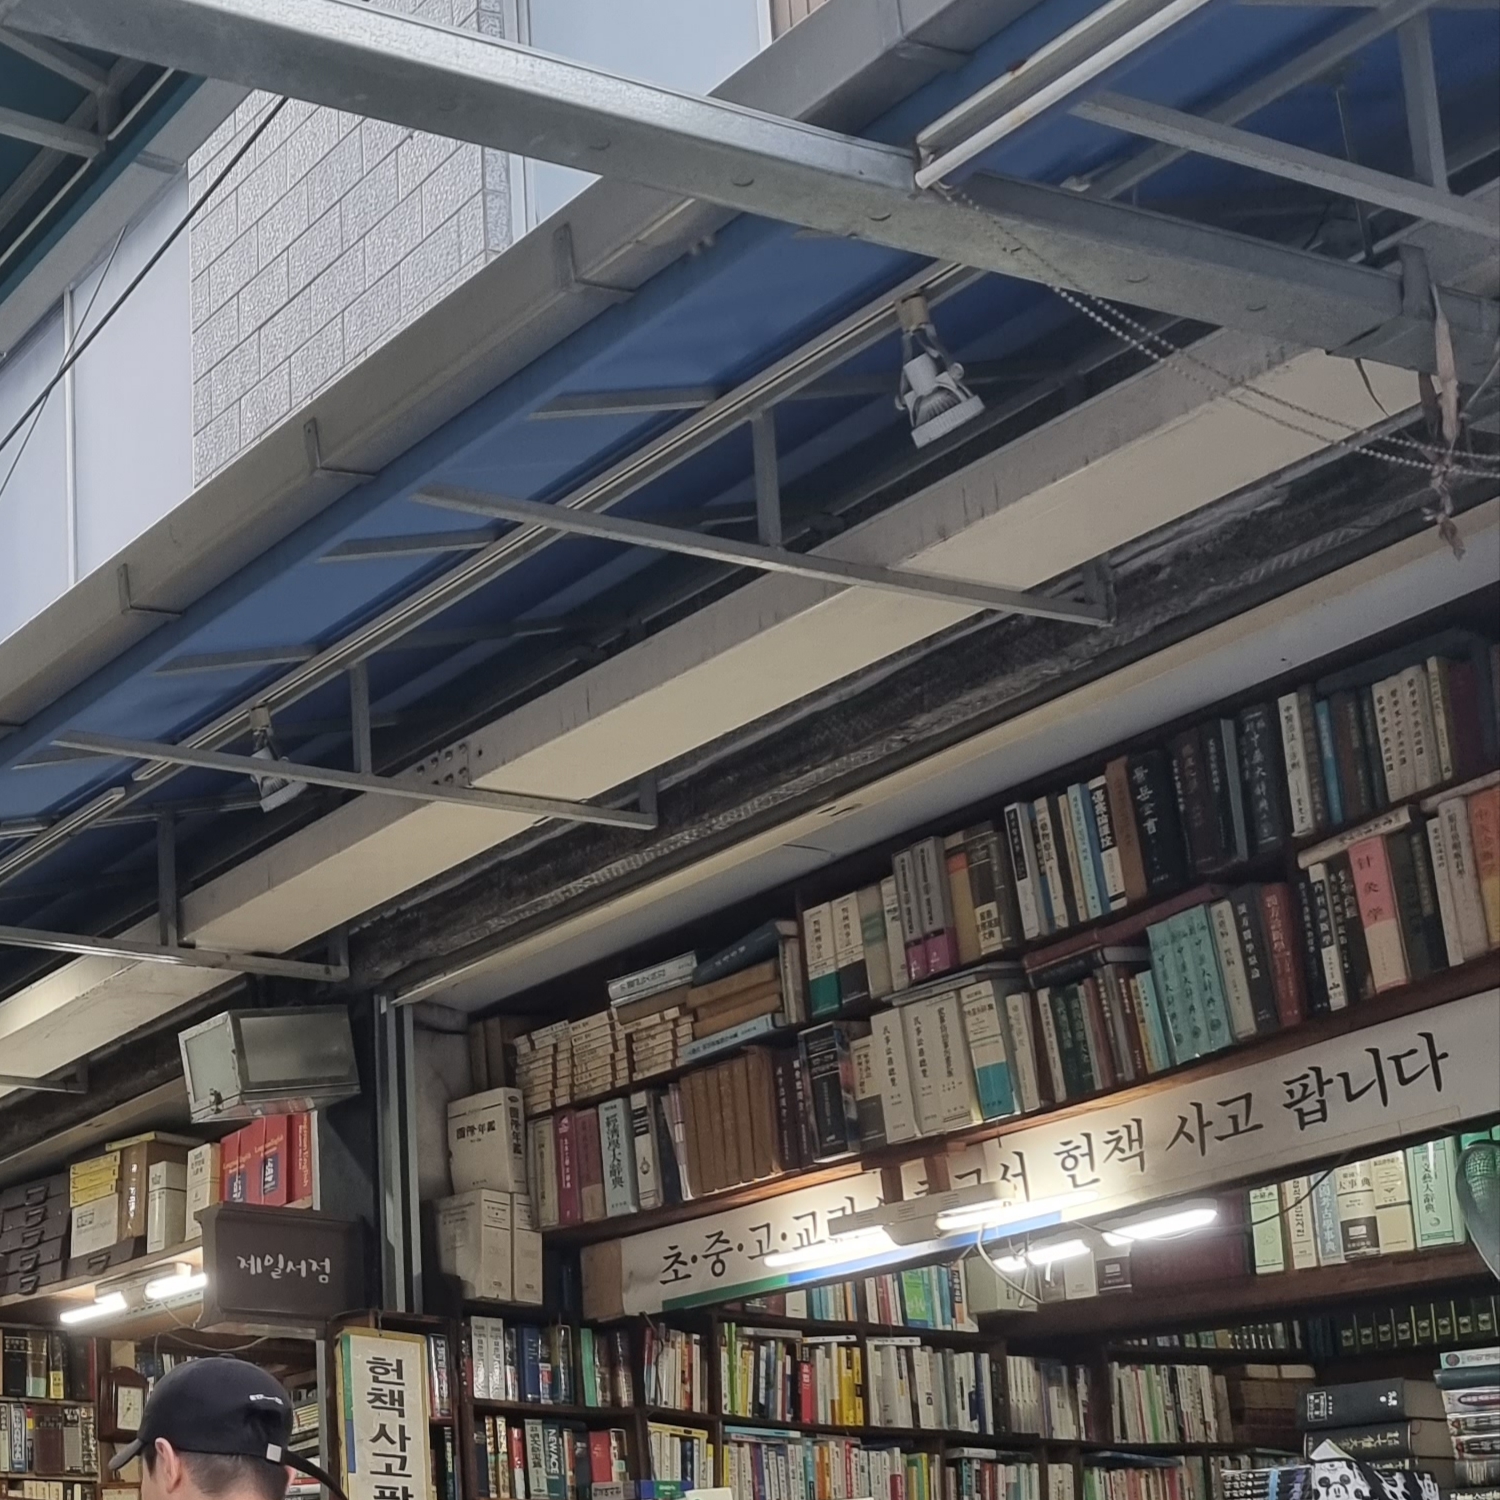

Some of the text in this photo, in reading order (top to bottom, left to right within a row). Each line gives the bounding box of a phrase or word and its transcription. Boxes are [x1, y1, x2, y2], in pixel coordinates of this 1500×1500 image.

[1054, 1117, 1145, 1186] 헌책
[1165, 1092, 1264, 1157] 사고
[1282, 1031, 1450, 1131] 팝니다
[237, 1253, 331, 1284] 제일서점
